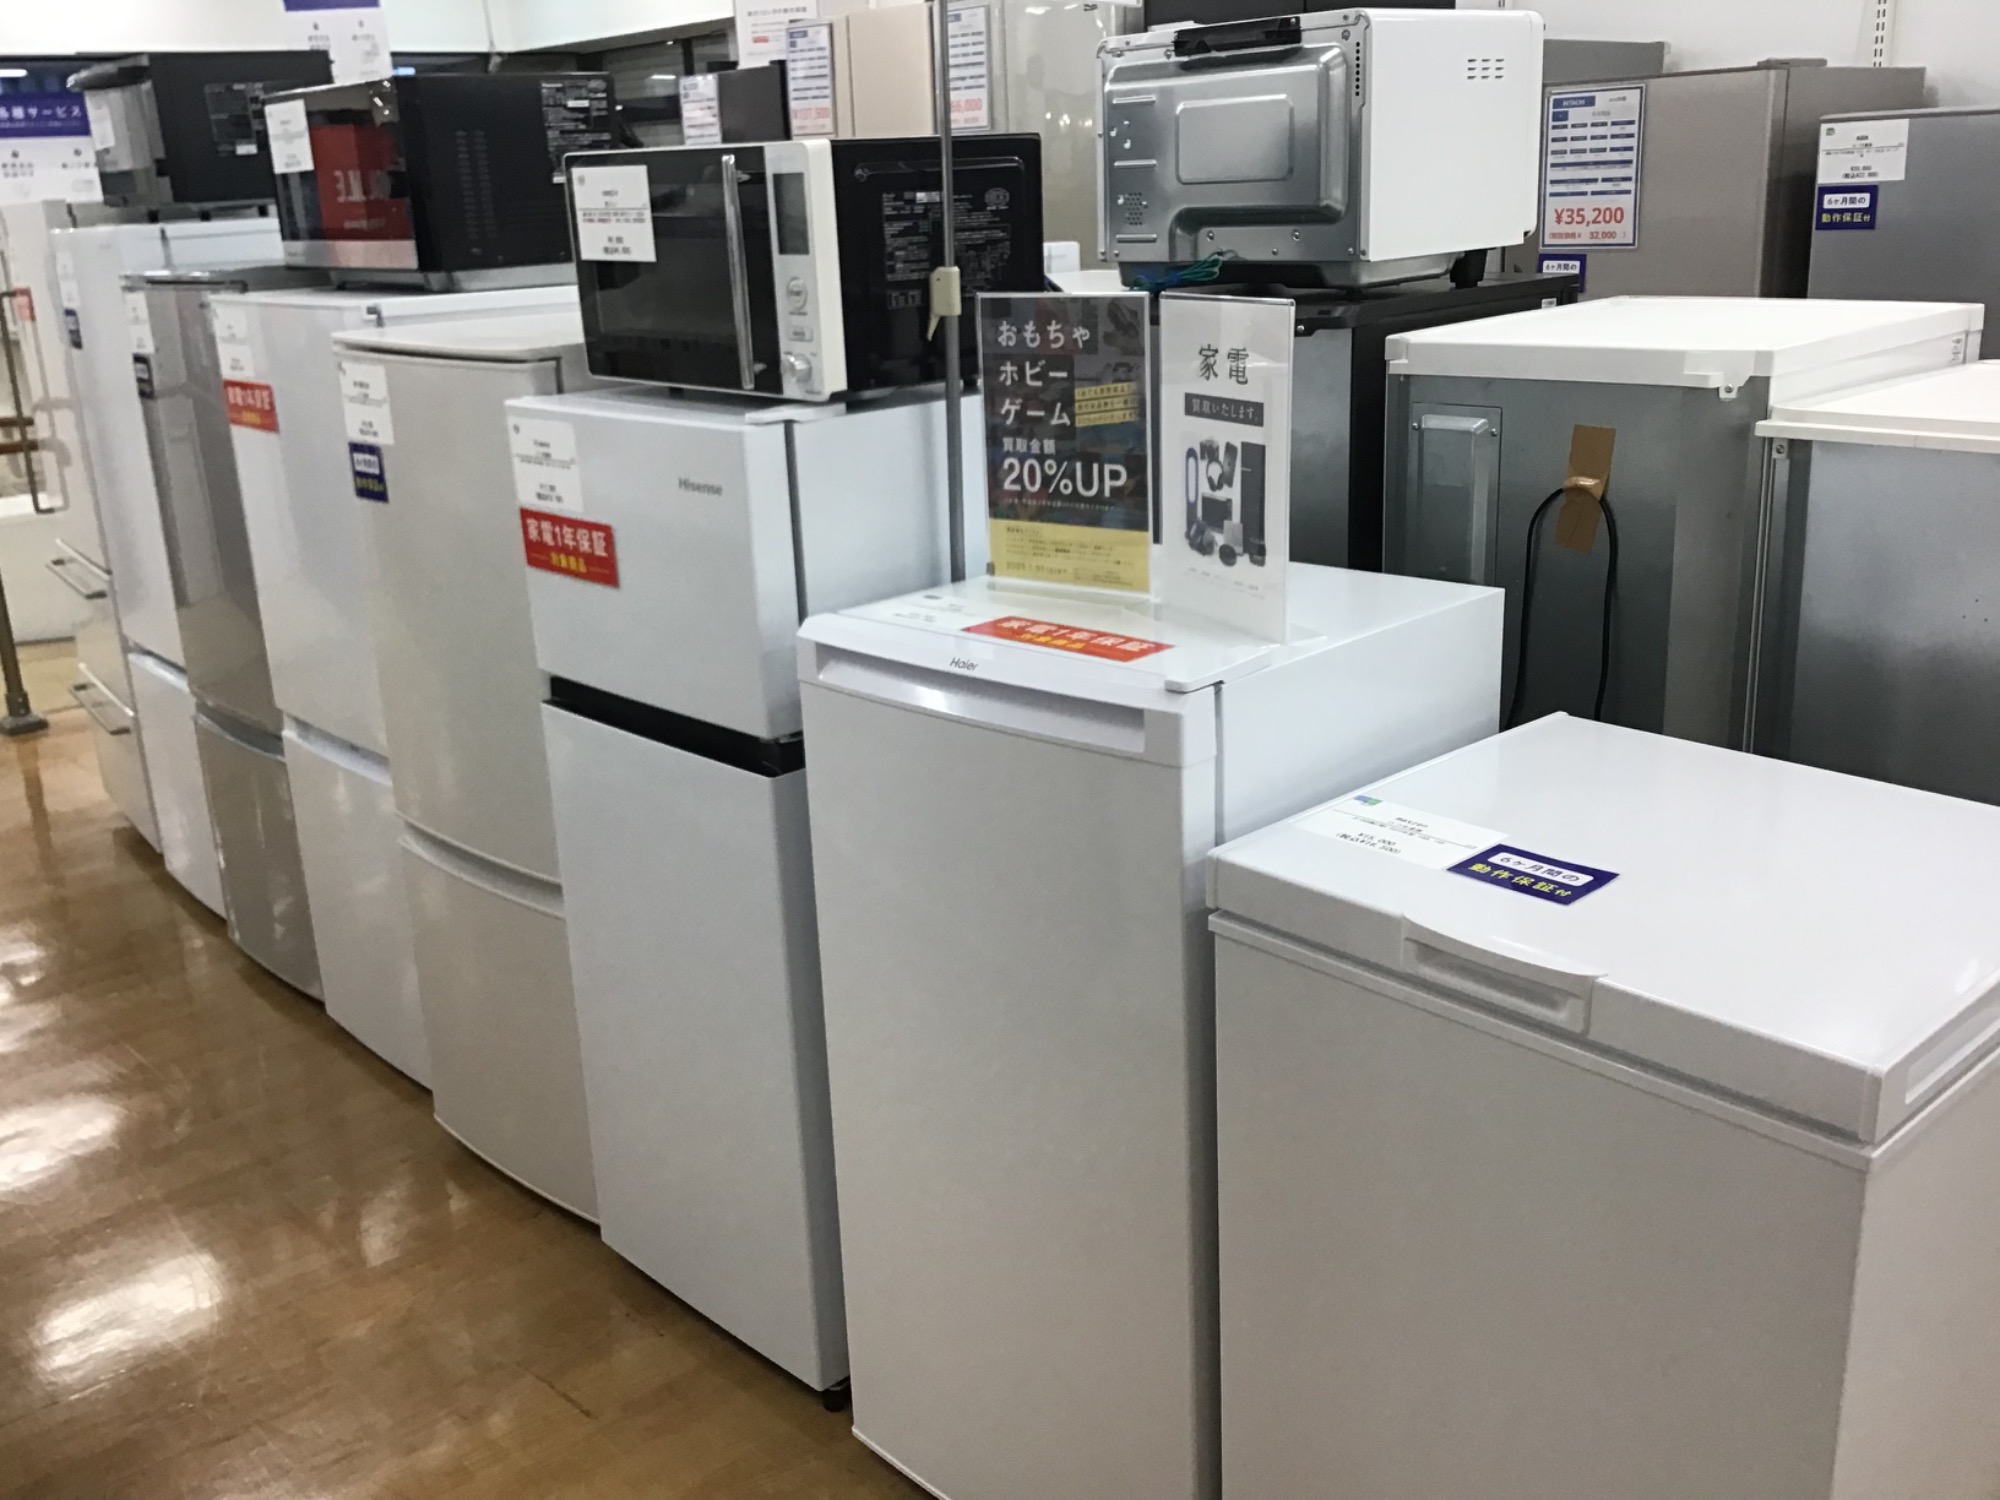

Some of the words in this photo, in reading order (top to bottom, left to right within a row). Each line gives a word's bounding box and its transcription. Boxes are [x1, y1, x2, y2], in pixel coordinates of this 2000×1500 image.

[1554, 207, 1625, 227] ¥35,200
[1589, 231, 1617, 240] 32,000
[998, 320, 1091, 349] おもちゃ
[1000, 359, 1068, 387] ホビー
[1198, 343, 1249, 385] 家電
[1001, 397, 1071, 426] ゲーム
[1003, 436, 1056, 455] 買取金額
[678, 476, 723, 497] Hisense
[1003, 457, 1128, 498] 20%UP
[526, 517, 609, 558] 家電1年保証
[949, 657, 978, 671] Haier
[1467, 863, 1572, 898] 動作保証付
